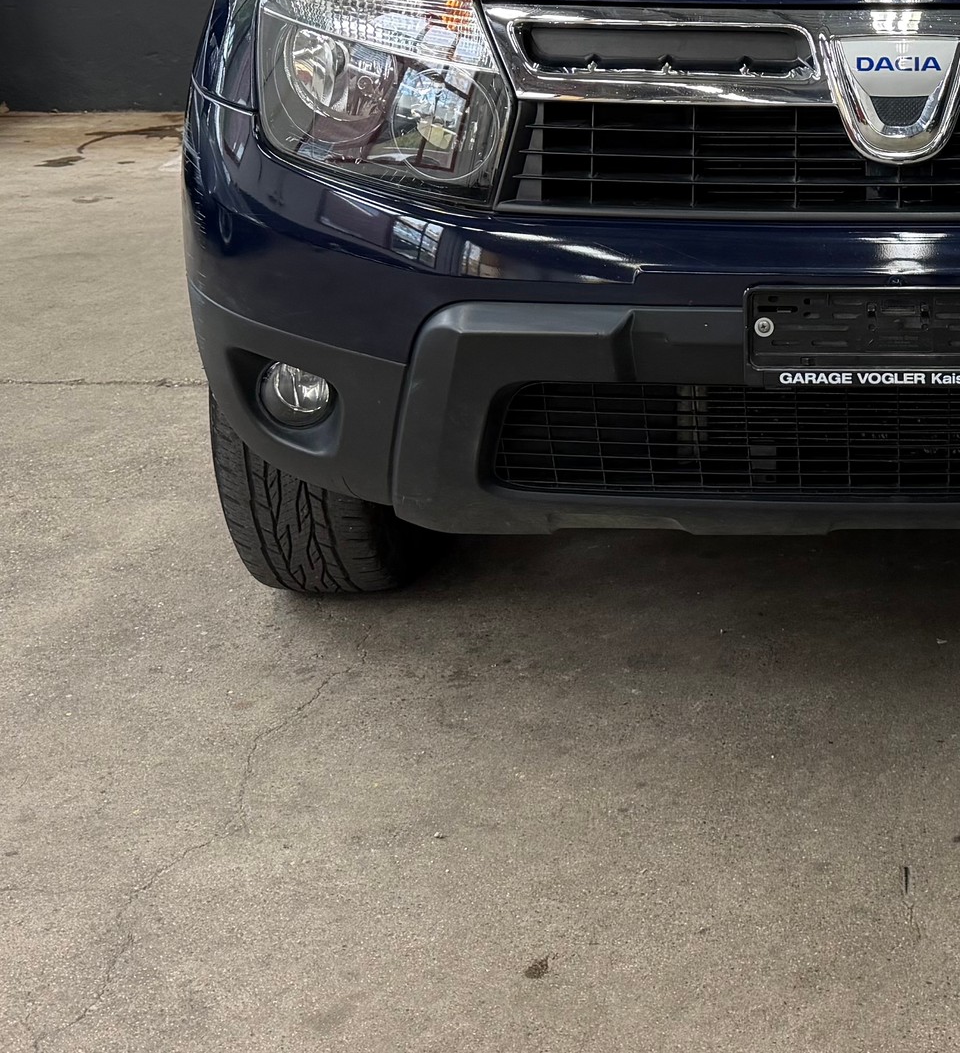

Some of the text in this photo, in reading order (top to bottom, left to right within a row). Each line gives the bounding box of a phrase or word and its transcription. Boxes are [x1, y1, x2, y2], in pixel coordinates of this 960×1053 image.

[857, 56, 942, 72] DACIA
[779, 372, 852, 385] GARAGE
[857, 372, 926, 385] VOGLER
